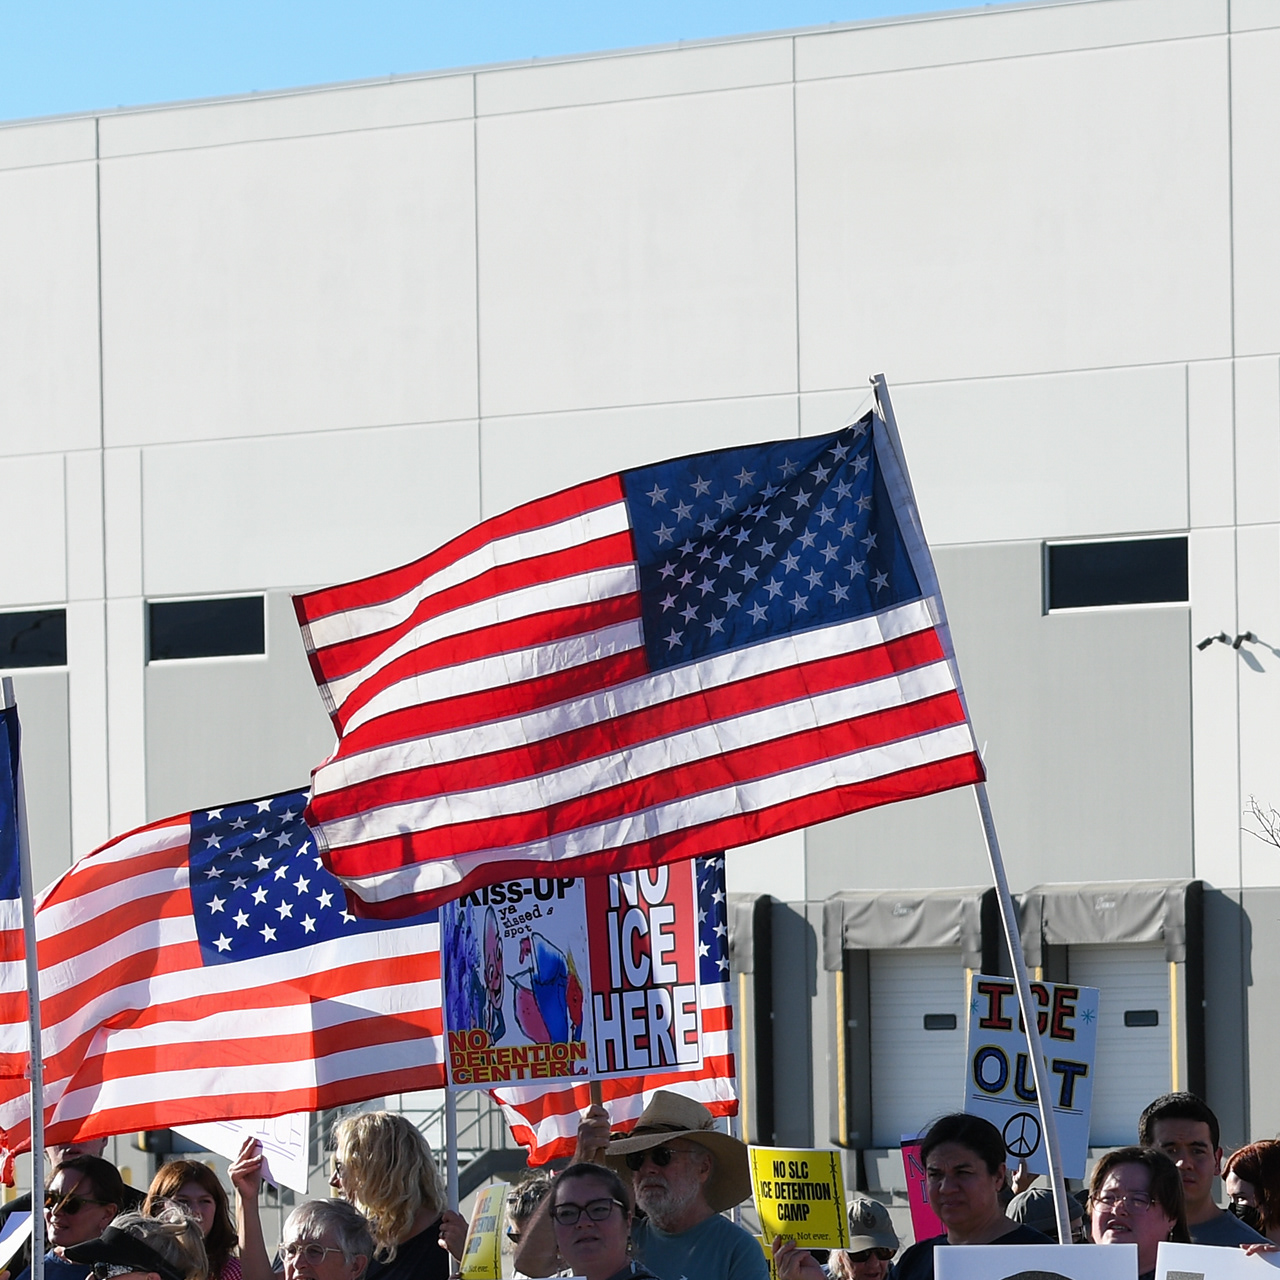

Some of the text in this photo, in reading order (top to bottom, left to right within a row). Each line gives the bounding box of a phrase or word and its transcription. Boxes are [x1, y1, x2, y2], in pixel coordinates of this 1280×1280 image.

[498, 904, 517, 920] ya
[504, 924, 532, 938] spot
[607, 904, 678, 989] ICE
[977, 981, 1079, 1042] ICE
[593, 984, 699, 1073] HERE
[448, 1030, 488, 1052] NO
[449, 1042, 587, 1069] DETENTION
[972, 1045, 1089, 1108] OUT
[773, 1160, 809, 1179] NO SLC
[760, 1181, 831, 1201] ICE DETENTION
[777, 1203, 810, 1221] CAMP
[797, 1232, 812, 1241] Not
[813, 1232, 831, 1241] ever.
